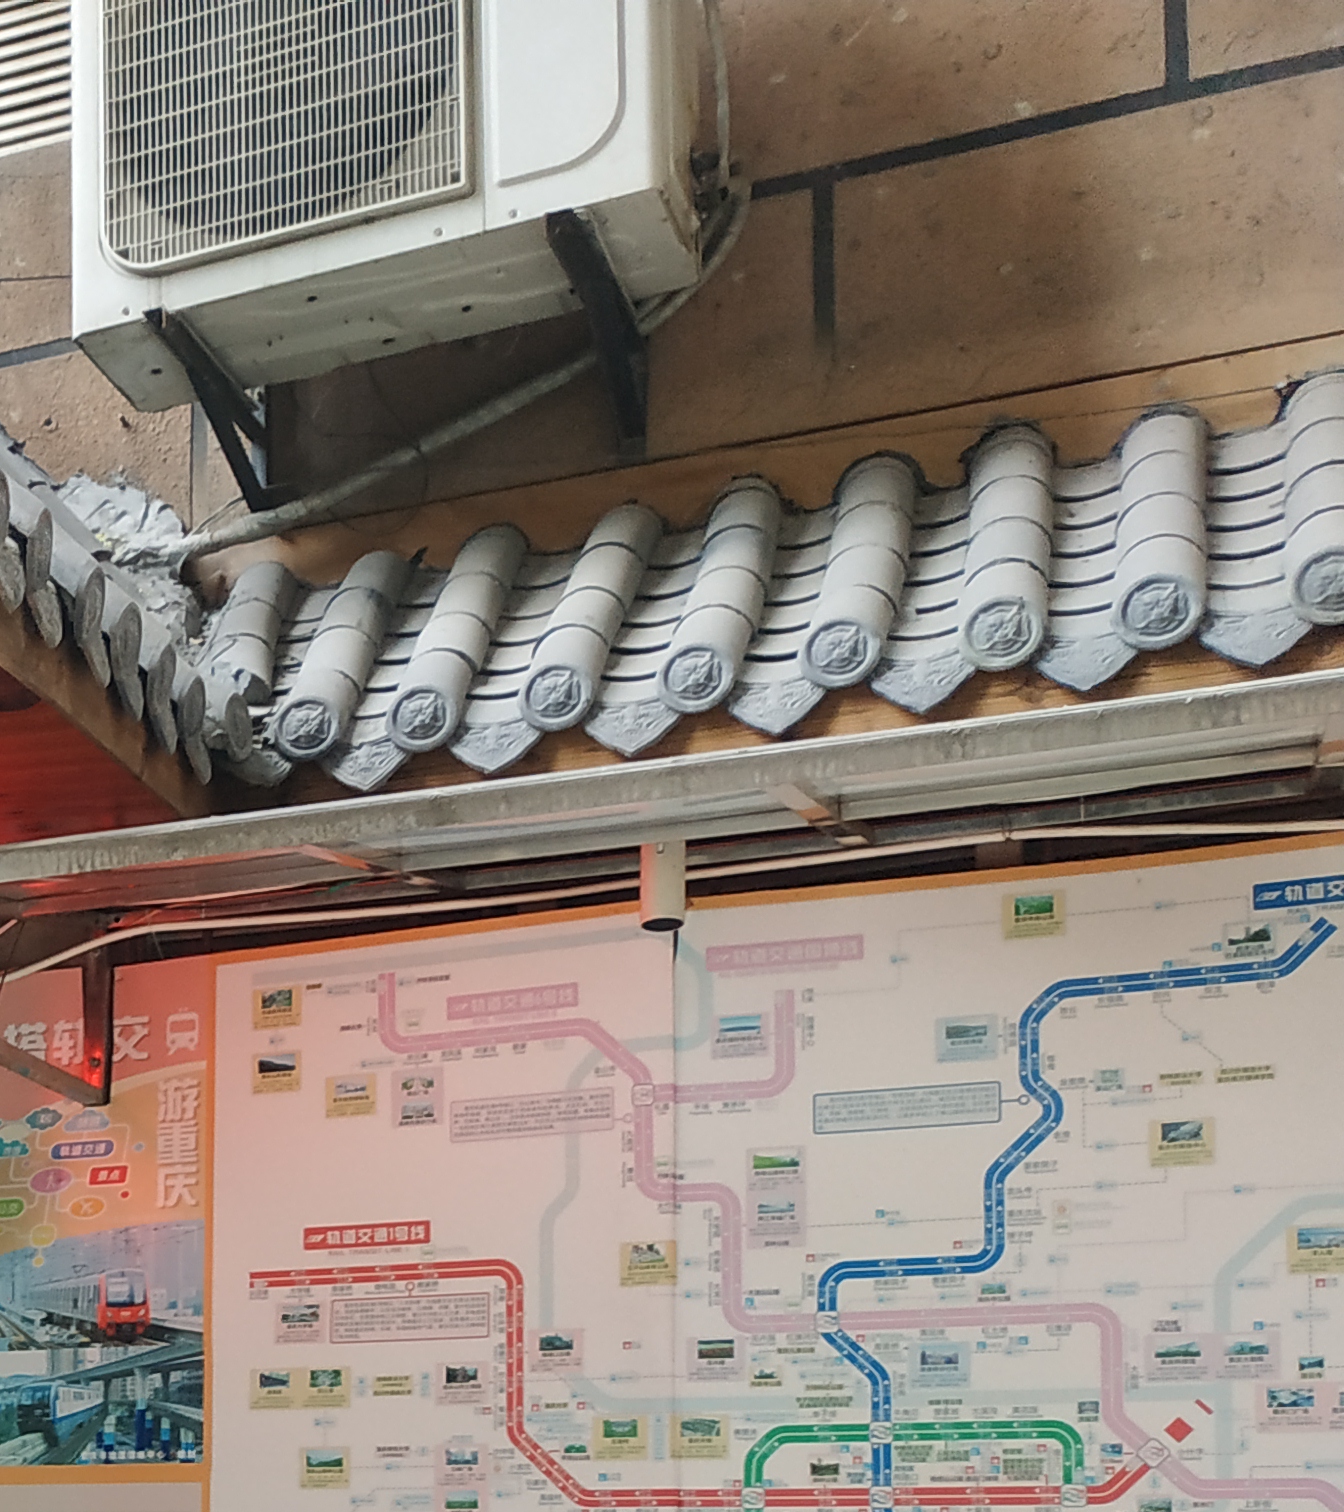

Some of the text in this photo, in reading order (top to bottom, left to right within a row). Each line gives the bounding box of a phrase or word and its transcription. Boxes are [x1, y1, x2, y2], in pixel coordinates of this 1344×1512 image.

[156, 1078, 200, 1208] 游重庆
[326, 1225, 425, 1245] 轨道交通1号线
